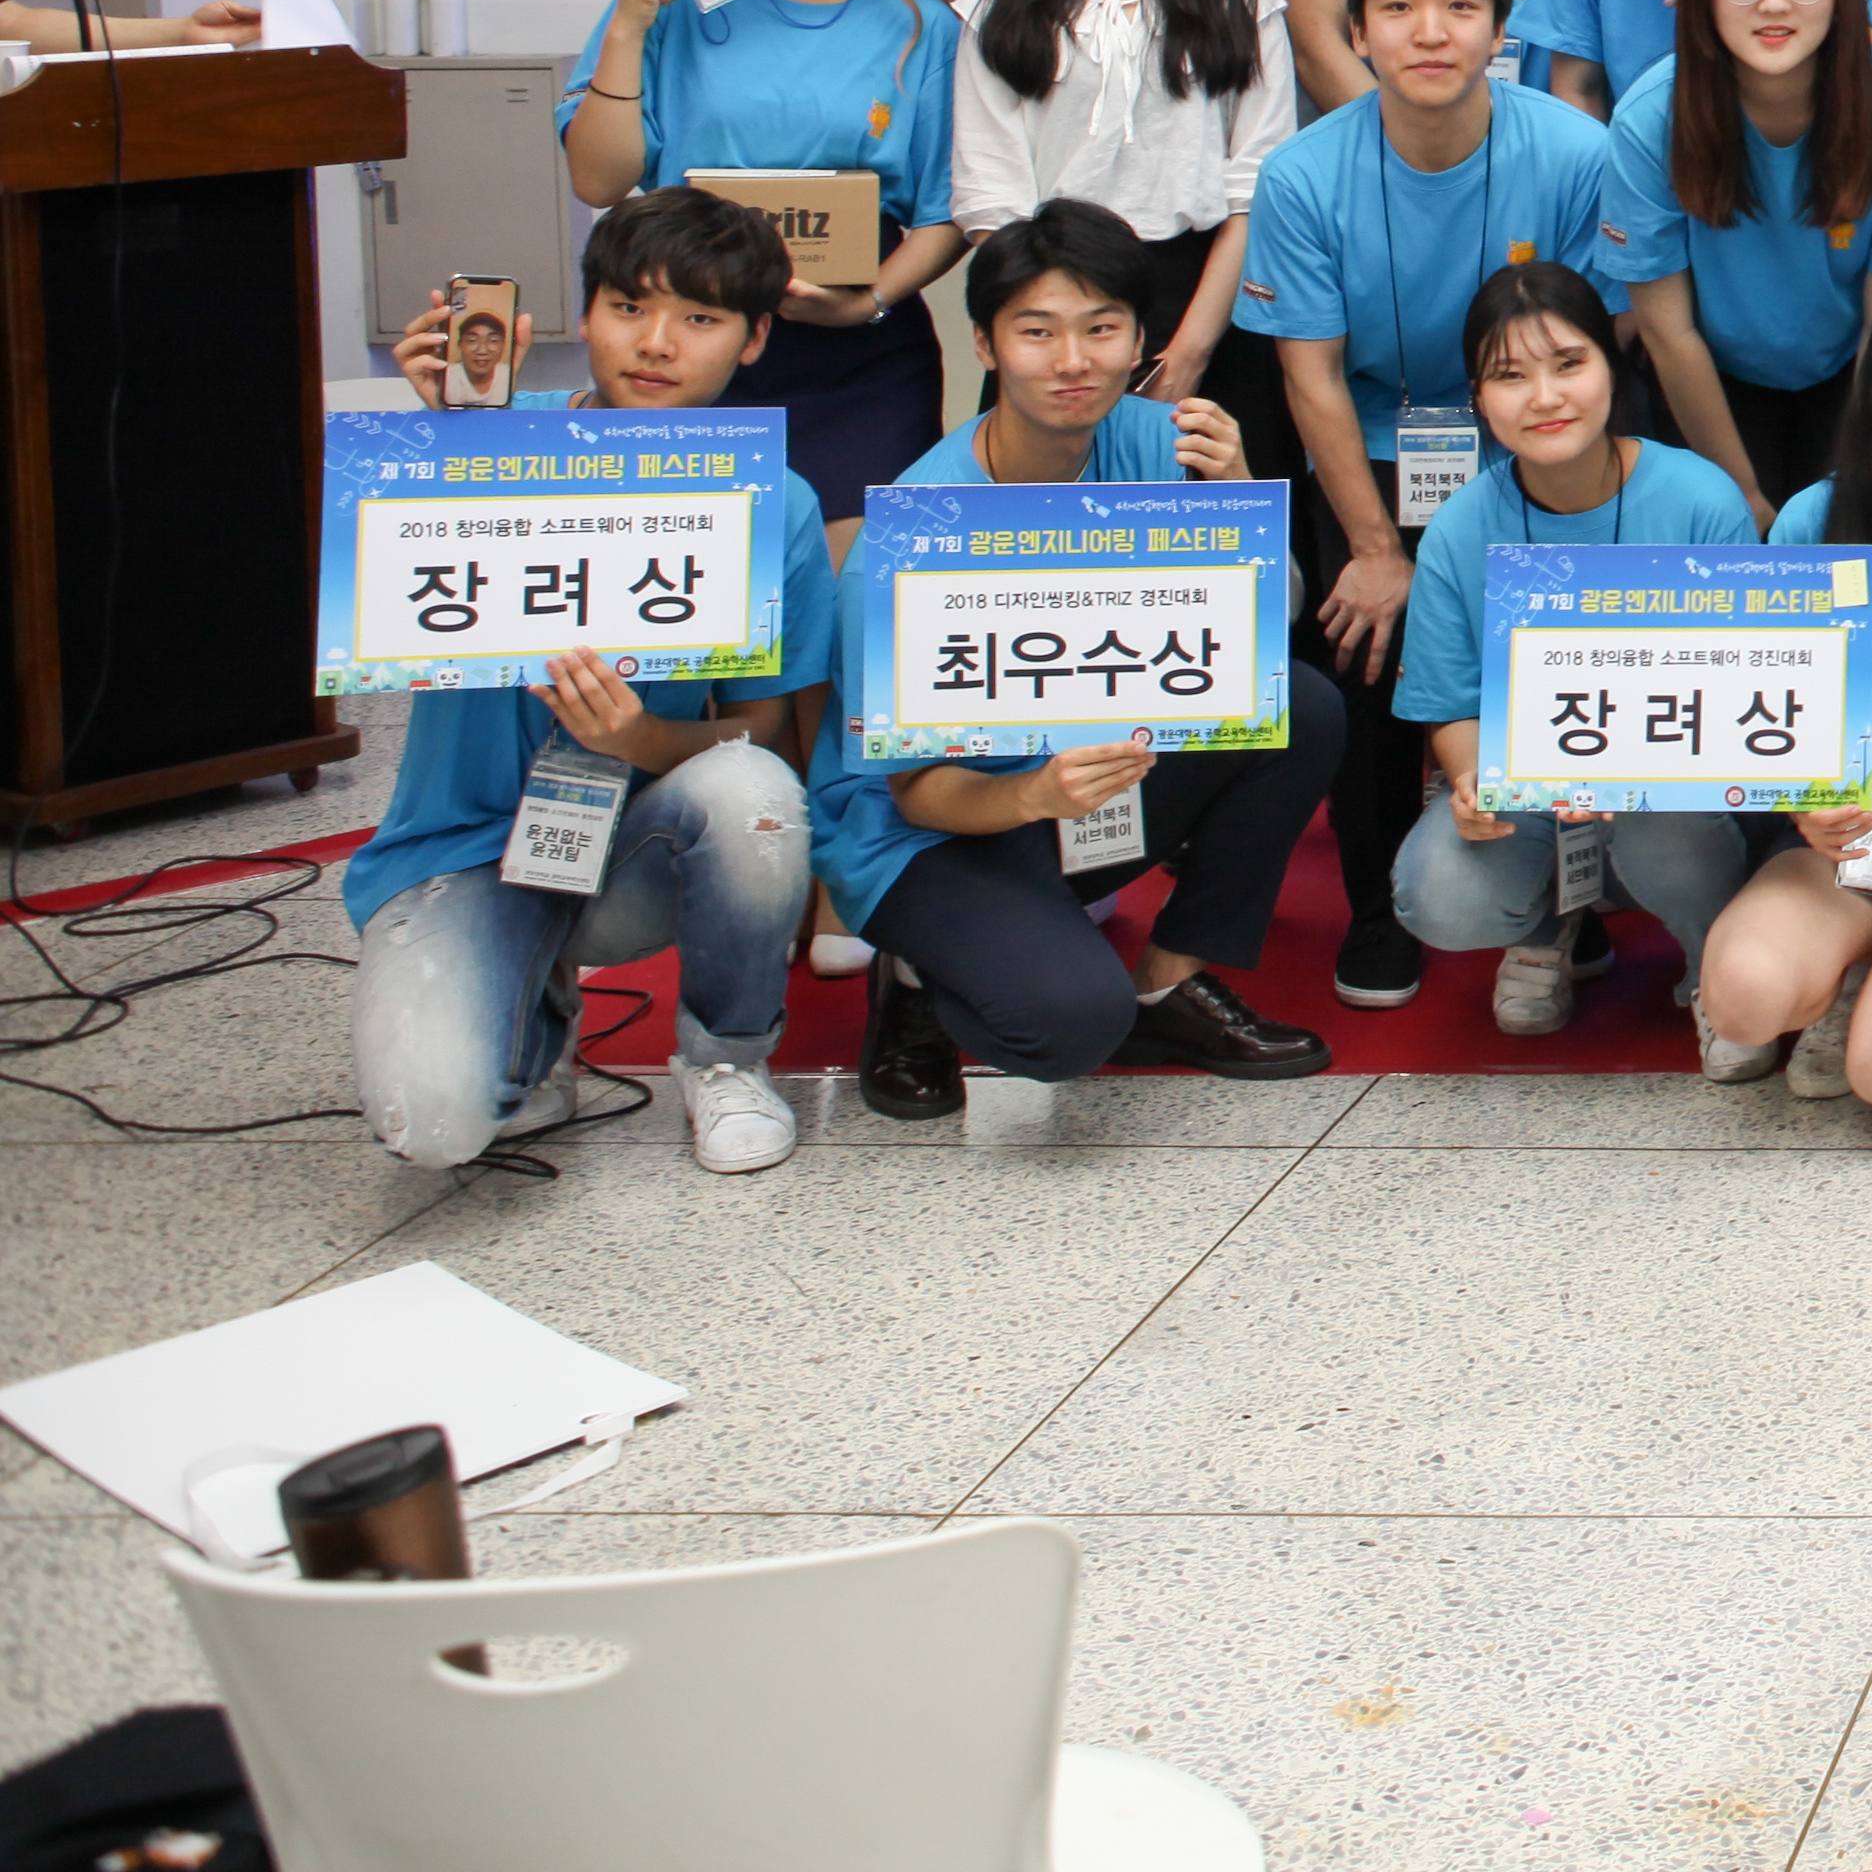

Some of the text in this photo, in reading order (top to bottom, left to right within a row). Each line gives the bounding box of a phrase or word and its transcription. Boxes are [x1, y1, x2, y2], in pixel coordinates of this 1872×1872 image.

[380, 453, 736, 483] 제 7회 광운엔지니어링 페스티벌
[400, 513, 714, 539] 2018 창의융합 소프트웨어 경진대회
[912, 526, 1241, 556] 제 7회 광운엔지니어링 페스티벌
[944, 588, 1208, 610] 2018 디자인씽킹&TRIZ 경진대회
[933, 627, 1221, 701] 최우수상
[1543, 649, 1813, 668] 2018 창의융합 소프트웨어 경진대회
